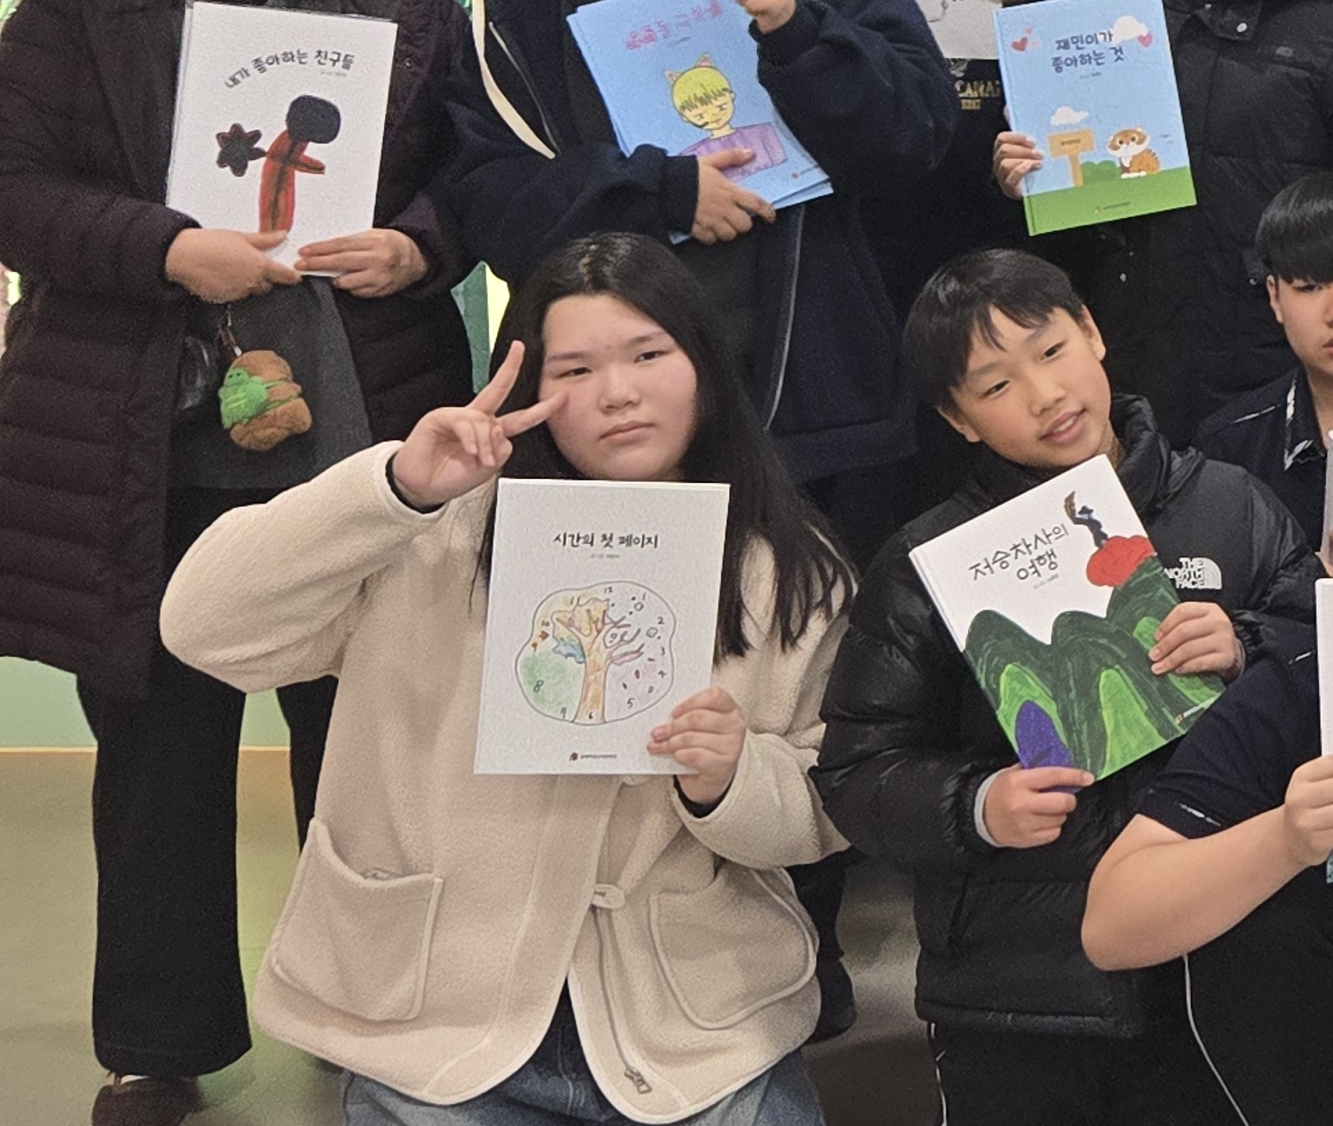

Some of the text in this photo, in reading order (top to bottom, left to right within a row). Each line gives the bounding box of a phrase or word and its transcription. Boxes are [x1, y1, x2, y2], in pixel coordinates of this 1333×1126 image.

[1055, 30, 1114, 51] 재민이가
[224, 49, 356, 89] 내가 좋아하는 친구들
[1051, 46, 1125, 73] 좋아하는 것
[553, 533, 659, 549] 시간의 첫 페이지
[968, 523, 1069, 581] 저승차사의
[1016, 550, 1059, 581] 여행
